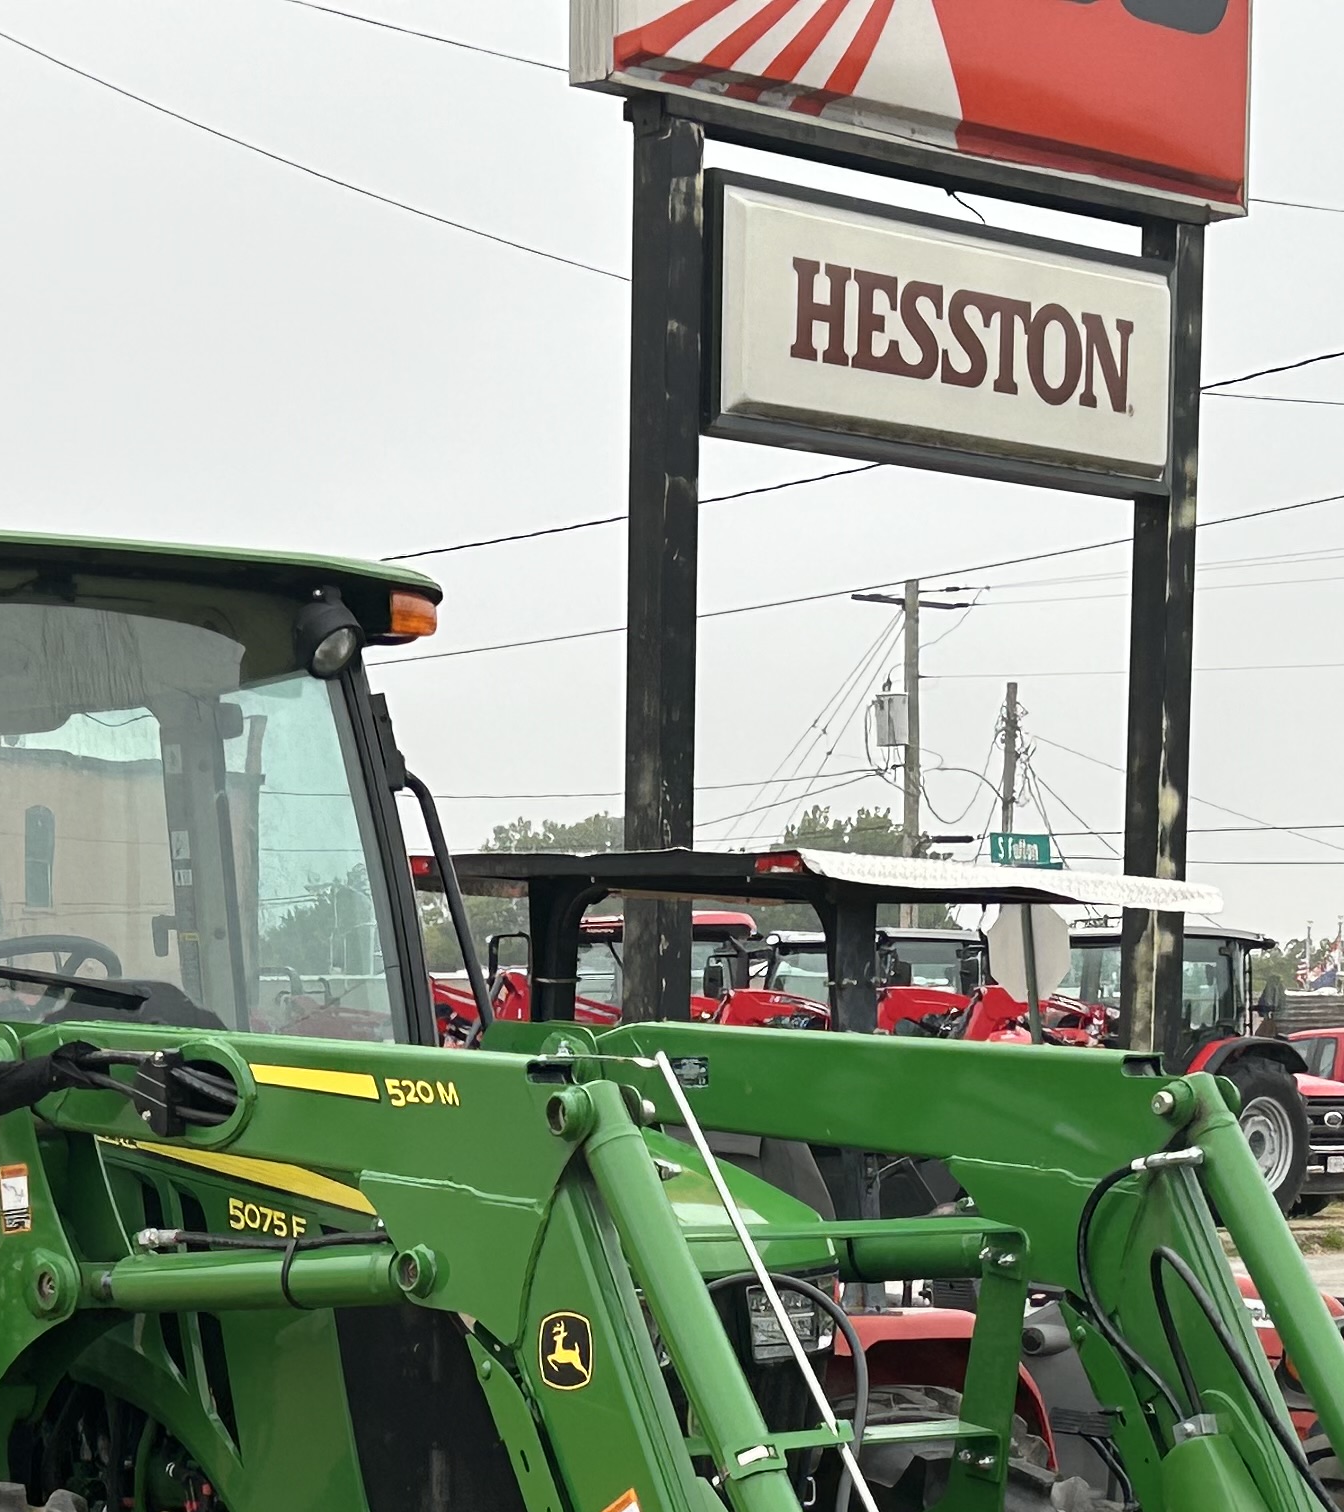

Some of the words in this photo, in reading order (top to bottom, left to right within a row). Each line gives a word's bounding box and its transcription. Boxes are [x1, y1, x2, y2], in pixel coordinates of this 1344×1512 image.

[790, 257, 1135, 413] HESSTON
[997, 836, 1005, 860] S
[384, 1077, 435, 1107] 520
[436, 1081, 460, 1107] M
[228, 1197, 288, 1238] 5075
